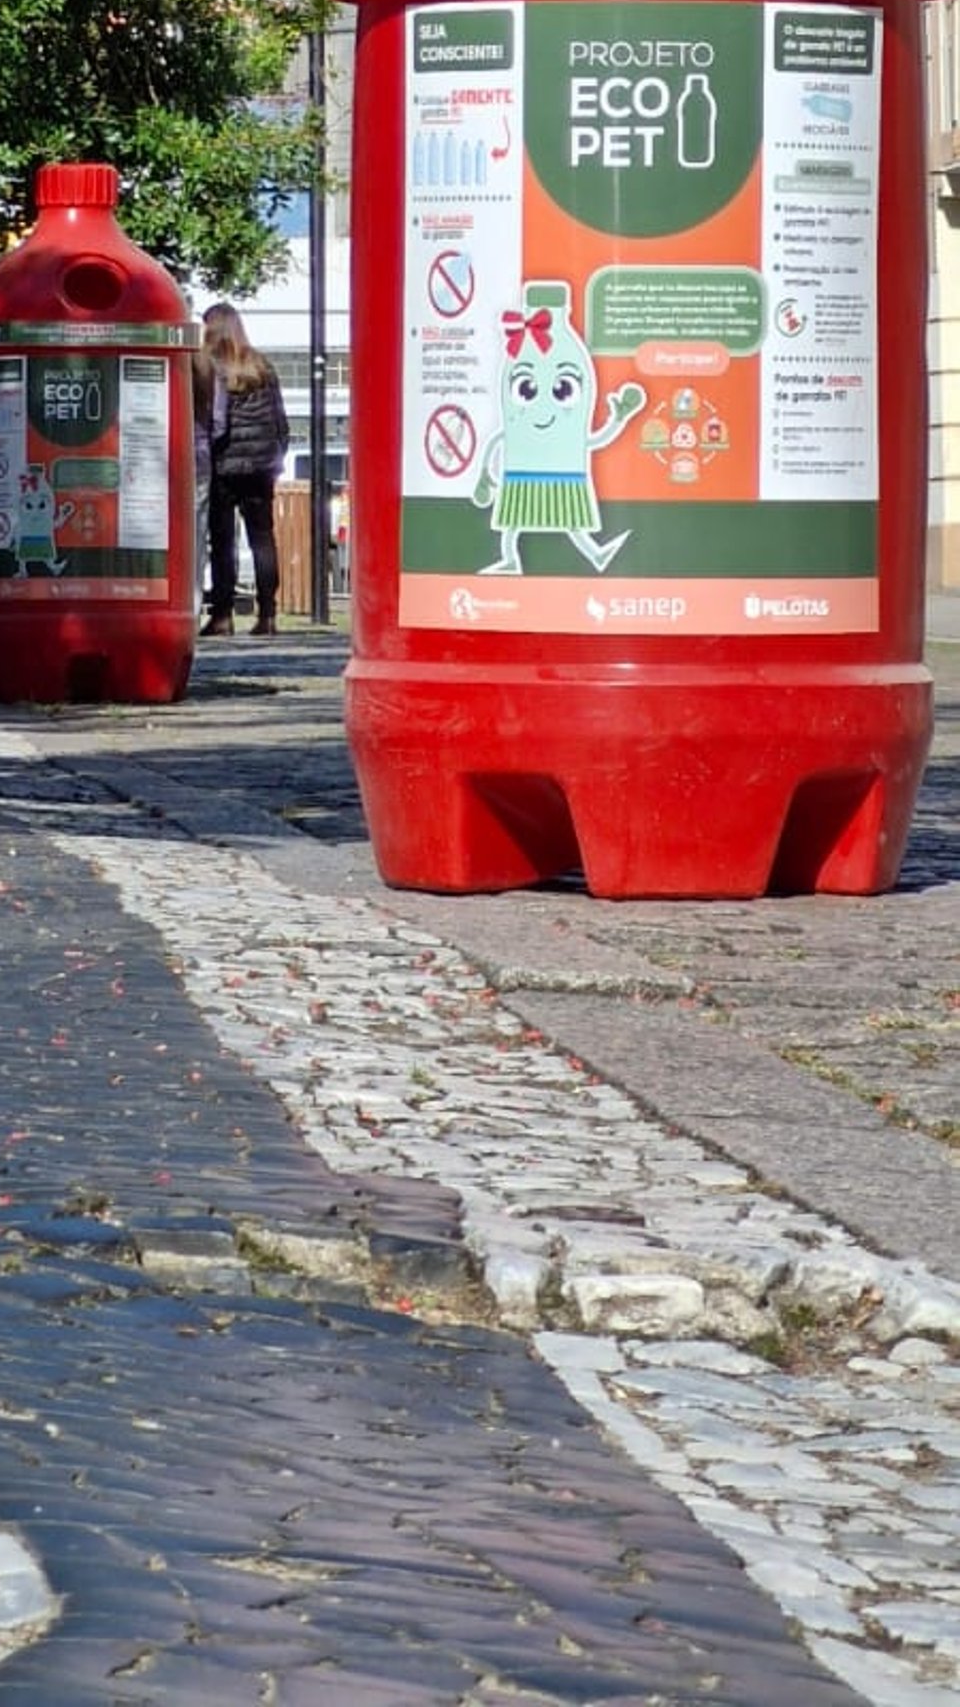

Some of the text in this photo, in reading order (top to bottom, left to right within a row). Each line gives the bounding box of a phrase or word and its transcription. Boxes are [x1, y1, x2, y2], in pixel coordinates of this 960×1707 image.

[420, 24, 447, 39] SEJA
[569, 41, 714, 67] PROJETO
[570, 77, 670, 118] ECO
[570, 126, 665, 167] PET
[44, 384, 83, 400] ECO
[44, 403, 81, 420] PET
[609, 594, 686, 619] sanep
[762, 597, 829, 616] PELOTAS
